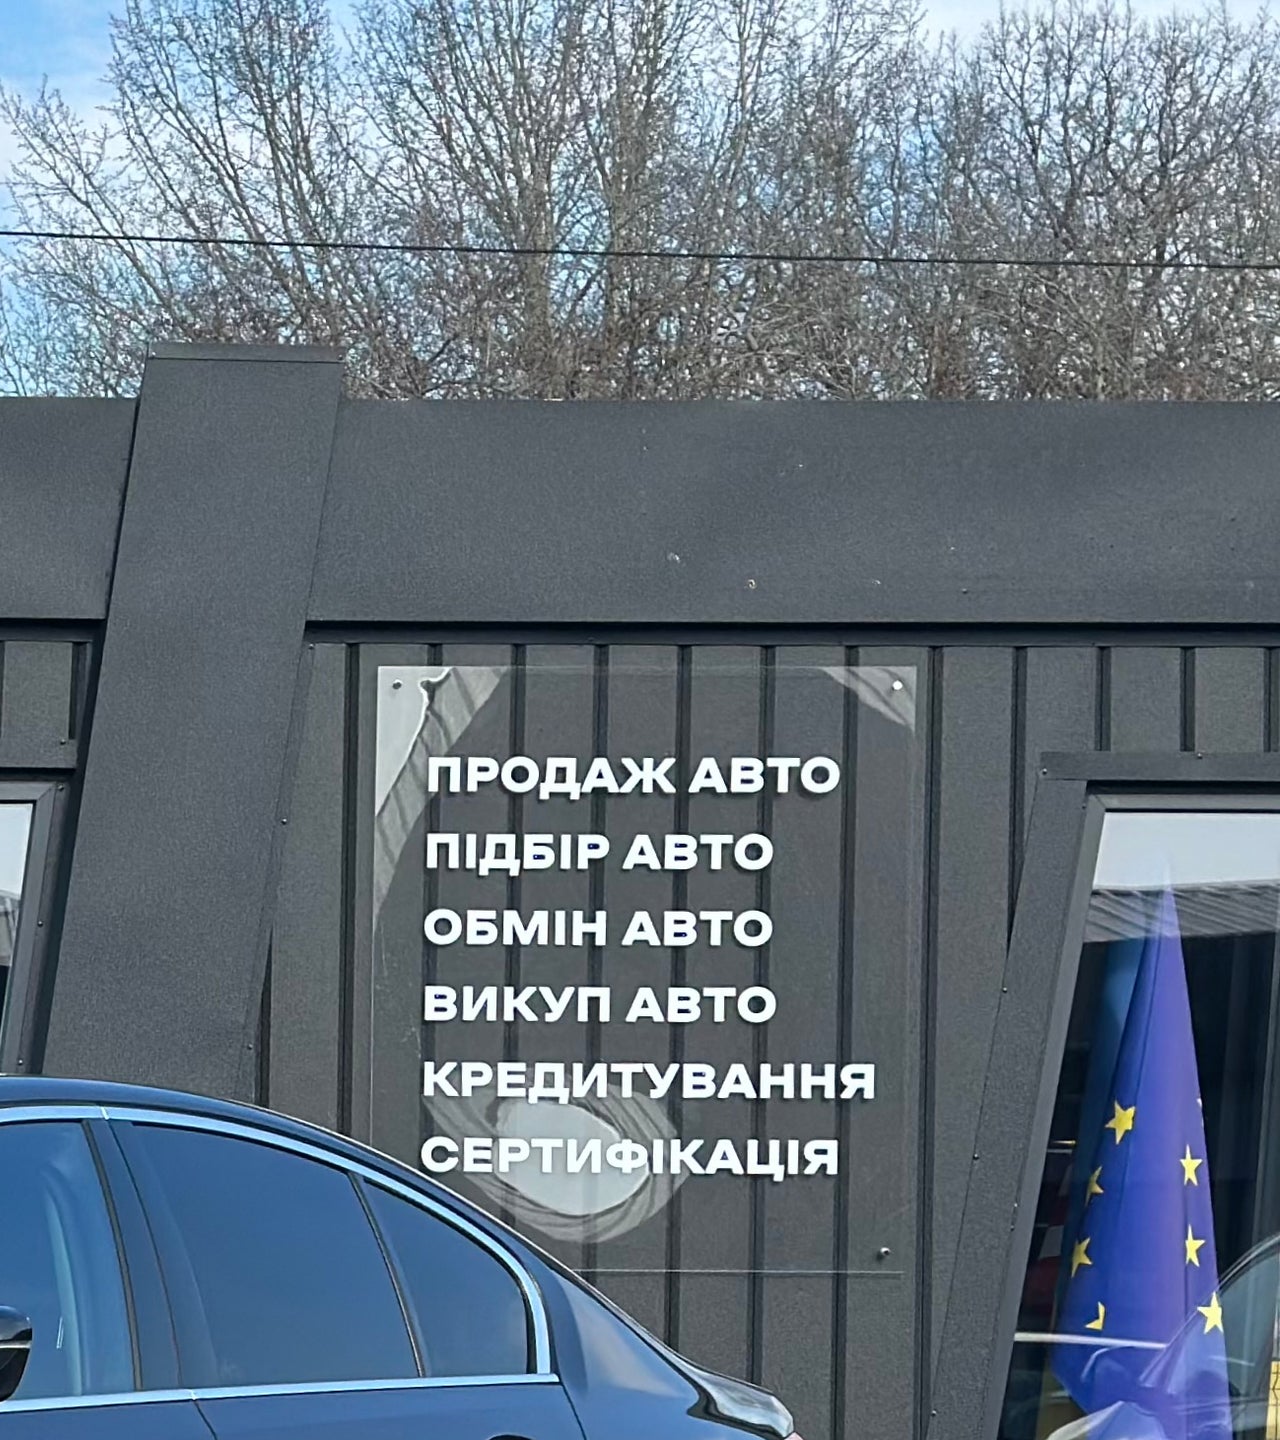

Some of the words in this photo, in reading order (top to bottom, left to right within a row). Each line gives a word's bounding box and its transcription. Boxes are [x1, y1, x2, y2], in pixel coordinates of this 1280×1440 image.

[427, 756, 676, 801] ПРОДАЖ
[689, 756, 841, 794] АВТО
[426, 833, 610, 877] ПІДБІР
[622, 834, 774, 871] АВТО
[423, 908, 607, 946] ОБМІН
[621, 910, 773, 947] АВТО
[424, 985, 611, 1023] ВИКУП
[625, 986, 777, 1023] АВТО
[423, 1061, 875, 1106] КРЕДИТУВАННЯ
[420, 1136, 839, 1182] СЕРТИФІКАЦІЯ
